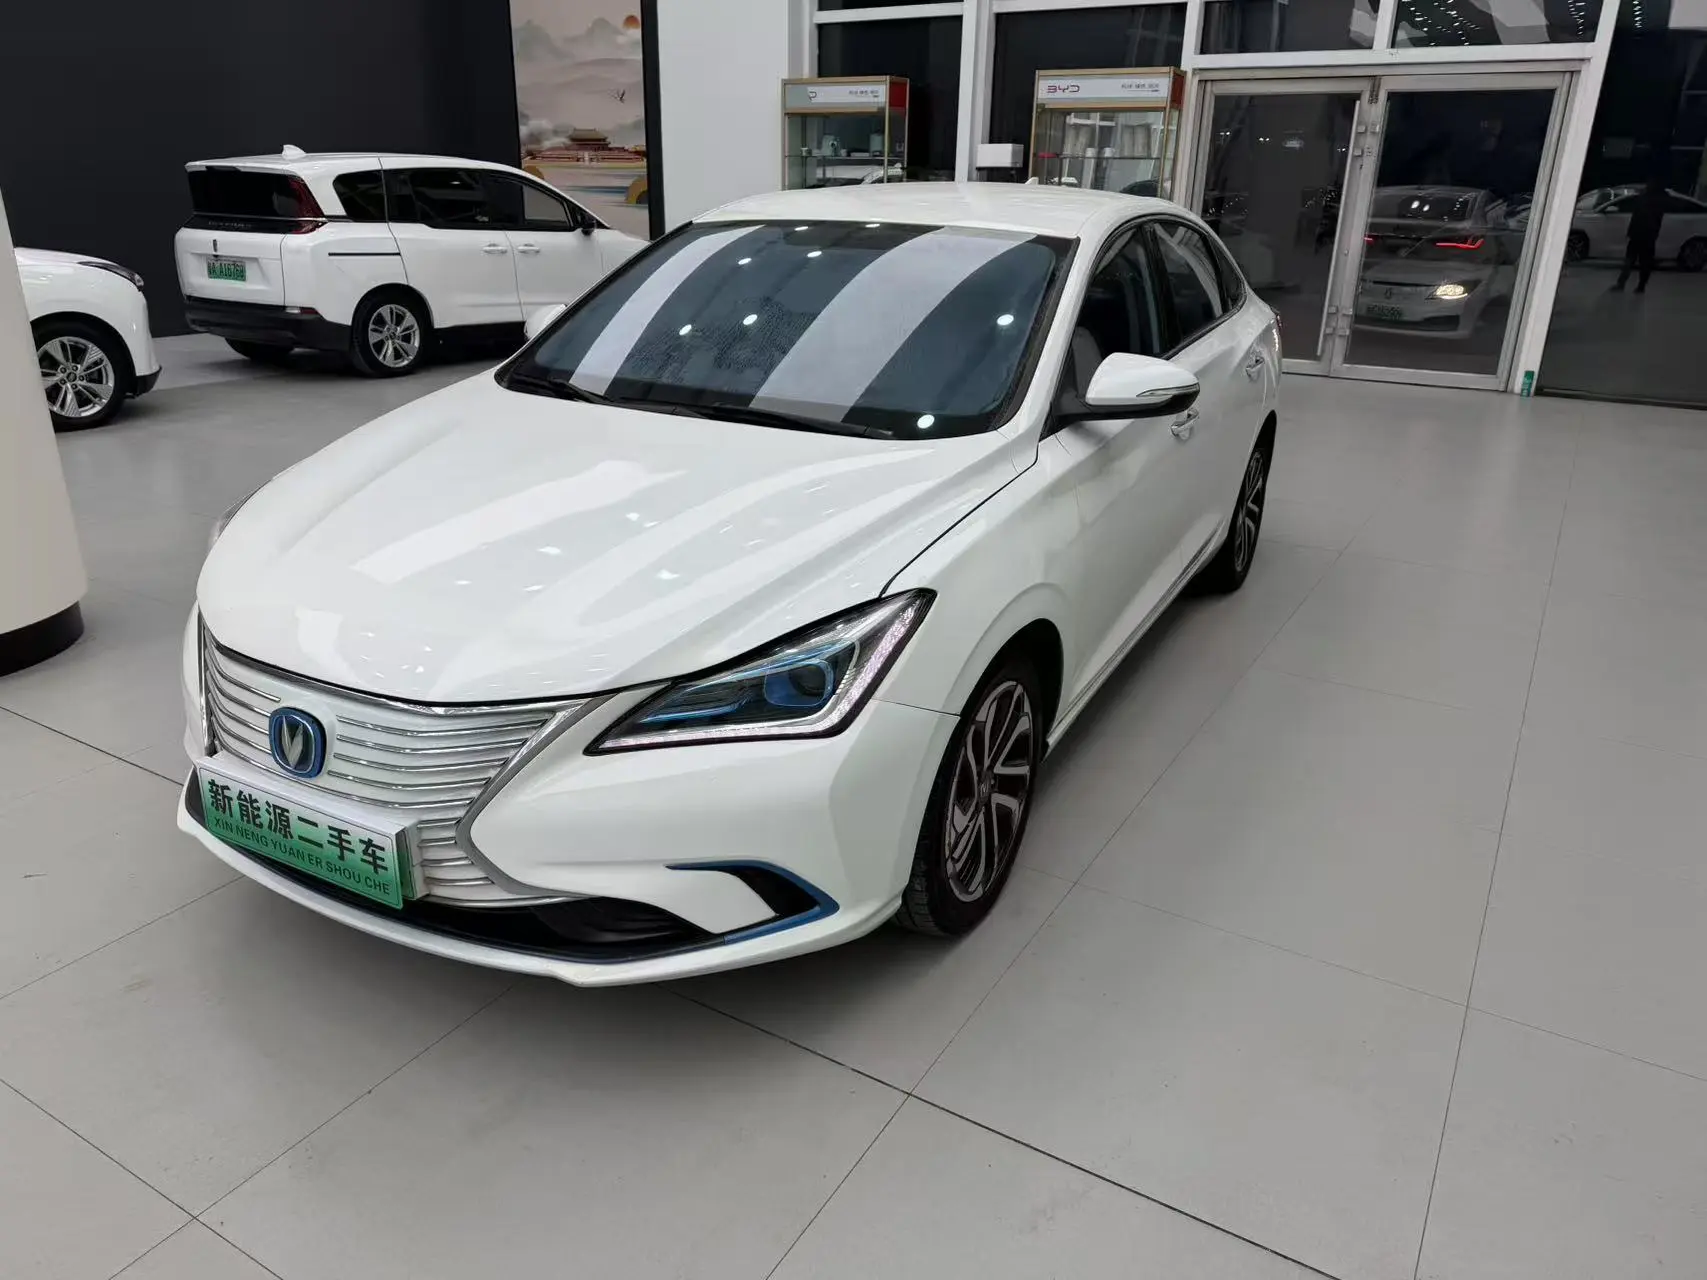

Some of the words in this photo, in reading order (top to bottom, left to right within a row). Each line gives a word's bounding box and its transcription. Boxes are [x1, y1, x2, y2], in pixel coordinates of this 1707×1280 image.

[1046, 84, 1081, 94] BYD
[207, 778, 388, 875] 新能源二手车
[214, 817, 234, 834] XIN
[235, 825, 269, 848] NENG
[270, 838, 305, 860] YUAN
[307, 853, 324, 870] ER
[325, 861, 361, 884] SHOU
[364, 876, 391, 896] CHE
